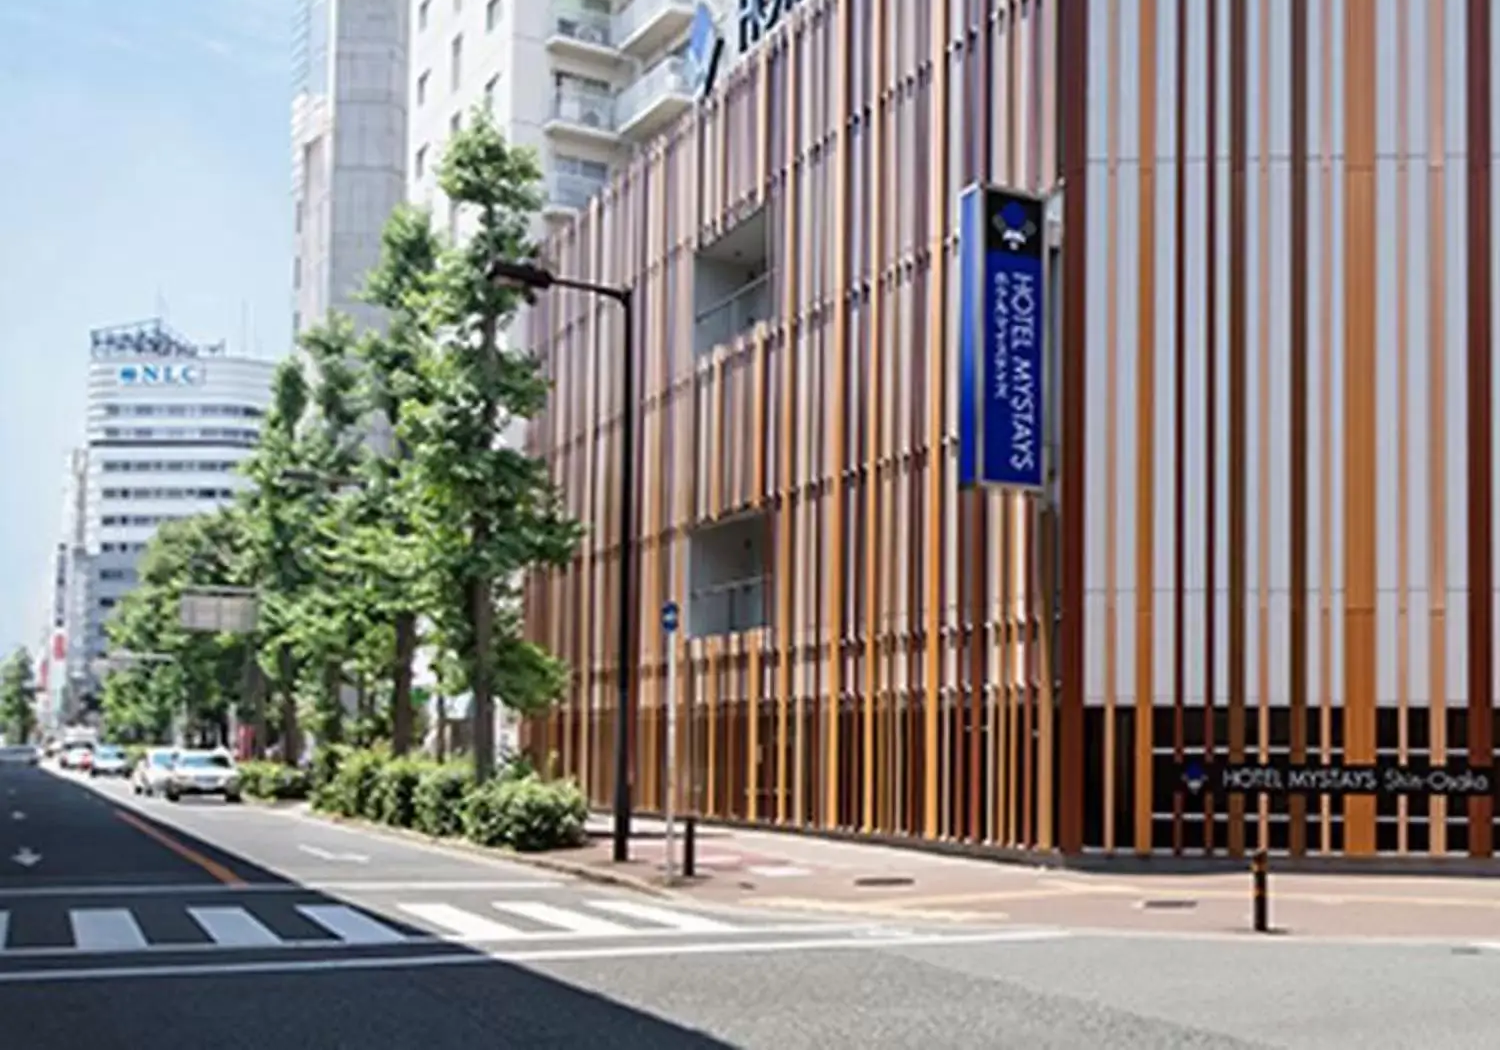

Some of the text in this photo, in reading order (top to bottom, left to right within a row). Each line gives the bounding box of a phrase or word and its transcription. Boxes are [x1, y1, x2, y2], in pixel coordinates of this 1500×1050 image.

[1009, 271, 1035, 471] HOTEL MYSTAYS
[1222, 767, 1283, 789] HOTEL
[1288, 768, 1377, 790] MYSTAYS
